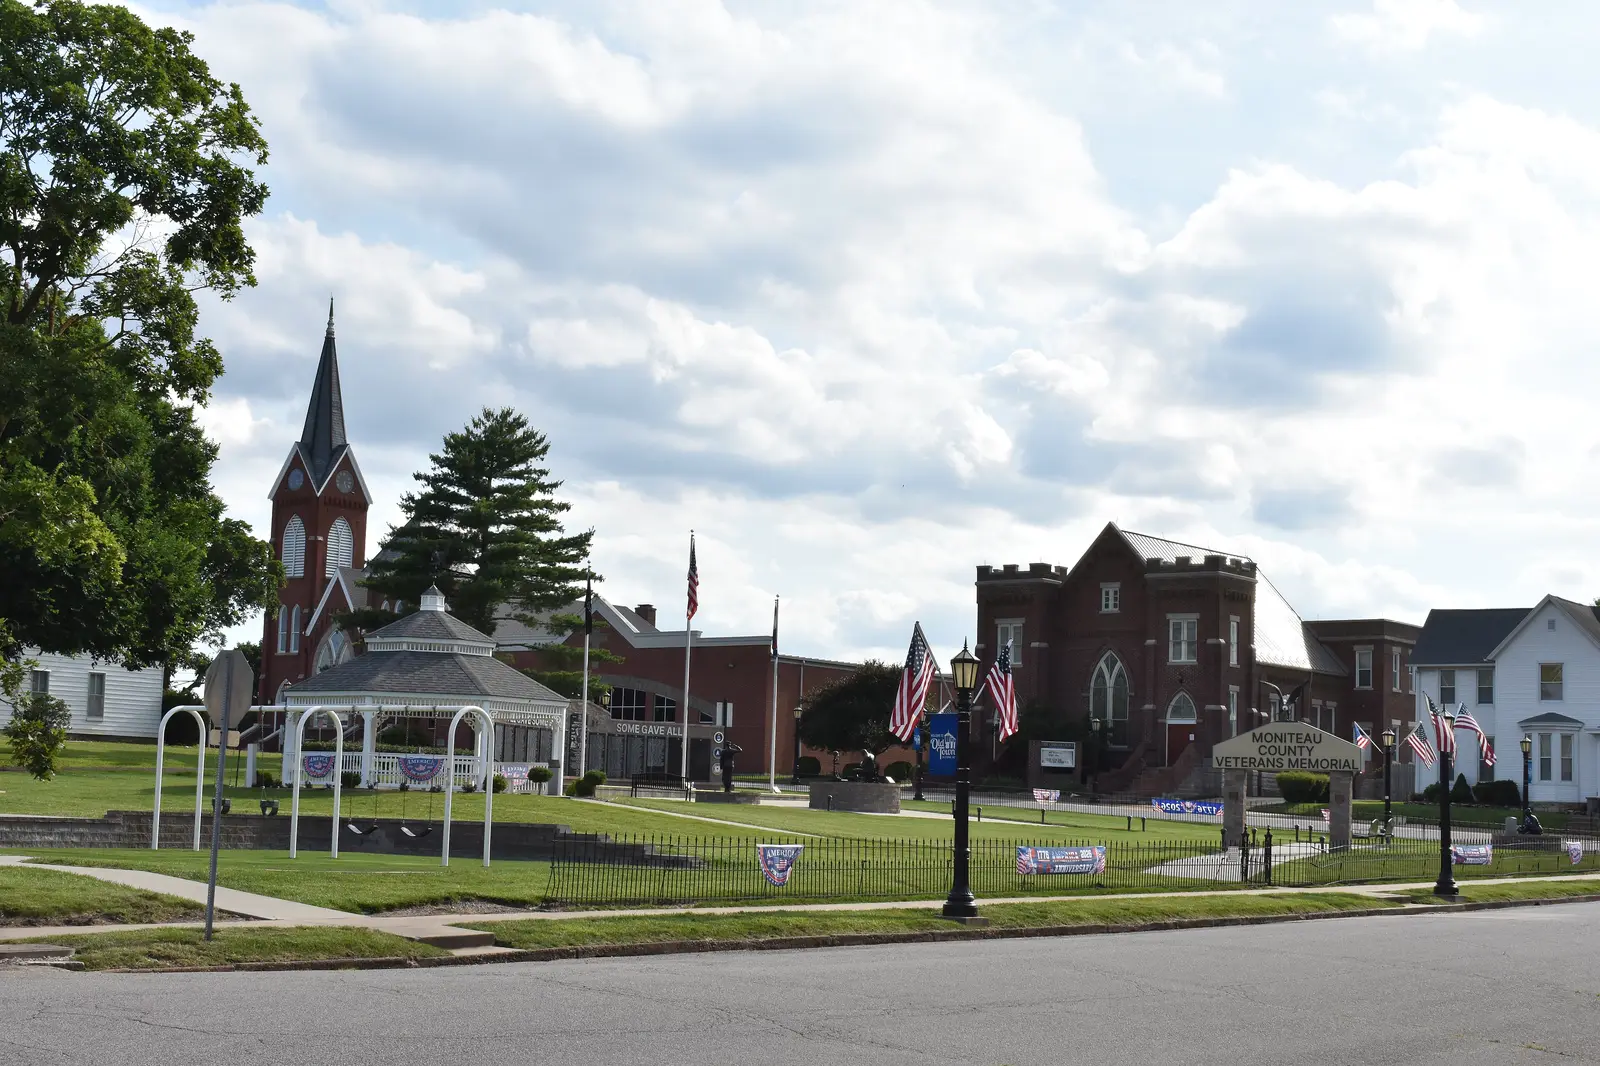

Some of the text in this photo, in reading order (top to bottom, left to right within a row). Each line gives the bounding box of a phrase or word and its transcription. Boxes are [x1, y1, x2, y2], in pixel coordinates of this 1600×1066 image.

[616, 723, 683, 737] SOME GAVE ALL
[930, 738, 944, 750] Old
[1252, 732, 1322, 744] MONITEAU
[936, 746, 956, 760] Town
[1258, 745, 1314, 756] COUNTY
[1216, 756, 1359, 770] VETERANS MEMORIAL
[1037, 850, 1050, 859] 1776
[1080, 849, 1092, 858] 2026
